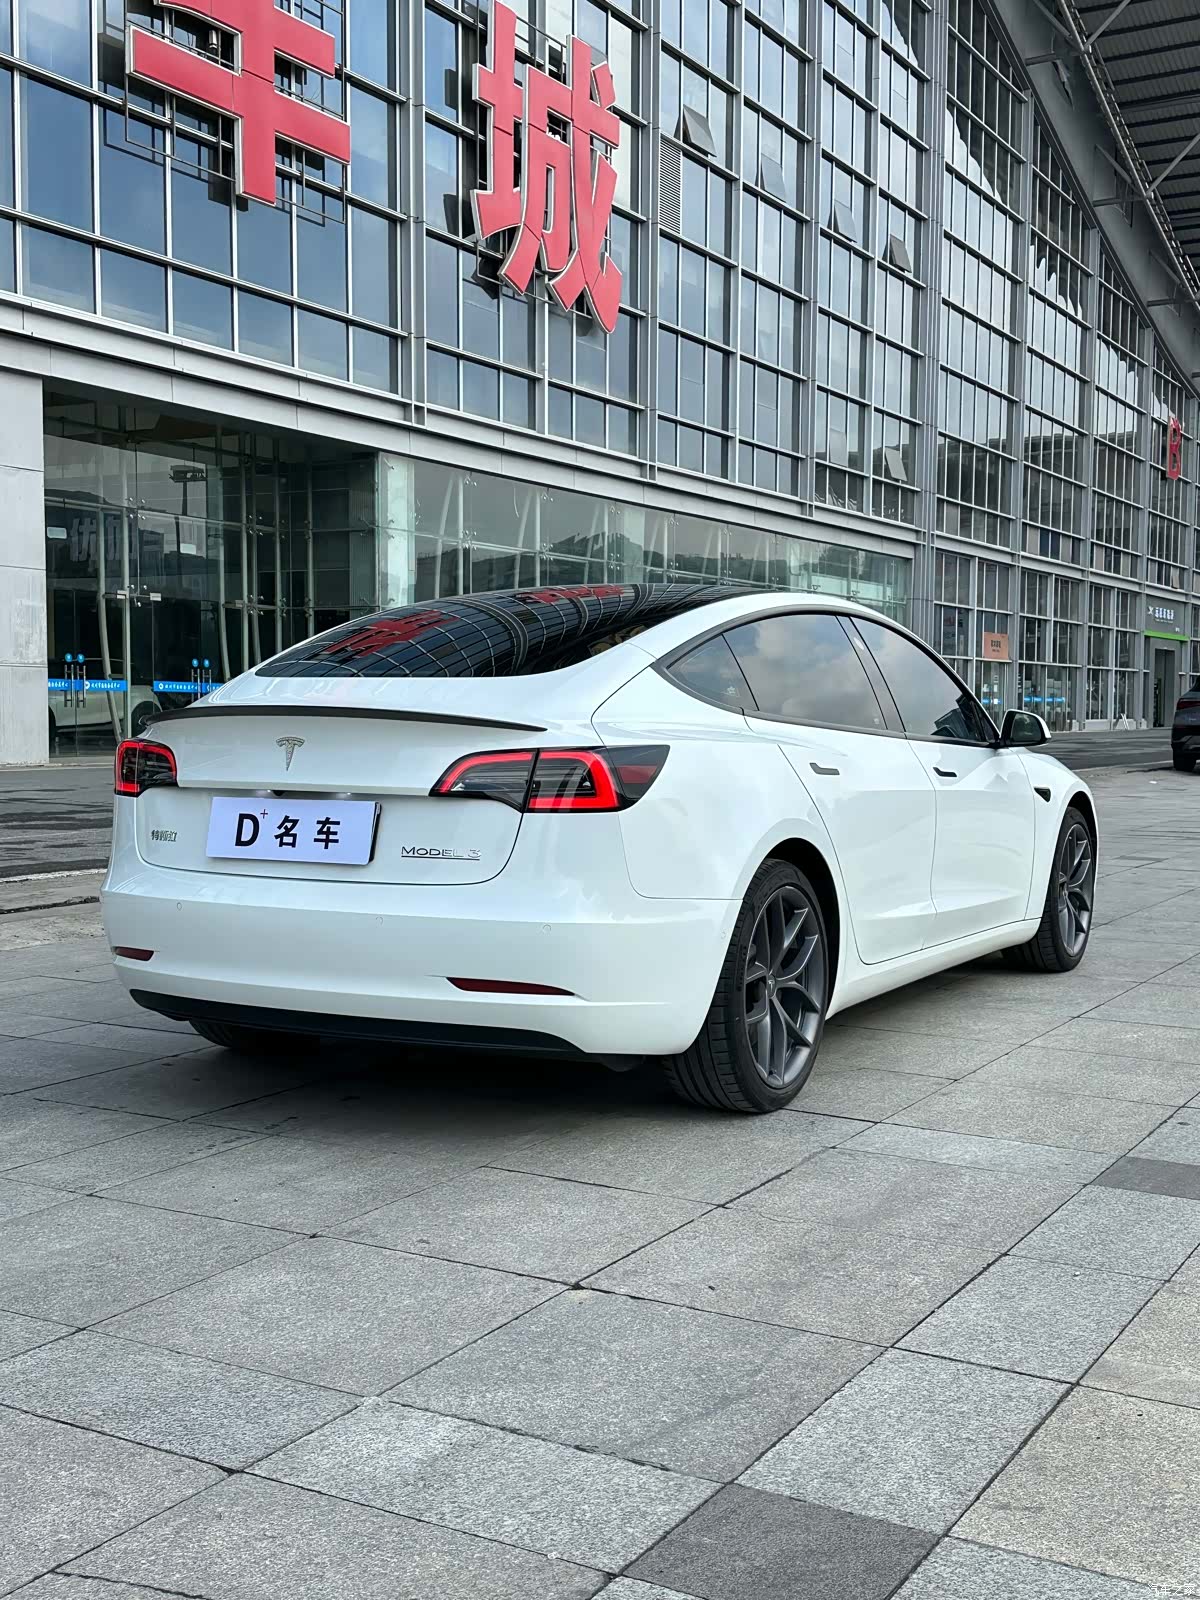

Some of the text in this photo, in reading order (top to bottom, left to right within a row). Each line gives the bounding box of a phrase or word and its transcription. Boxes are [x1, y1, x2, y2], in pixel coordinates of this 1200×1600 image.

[274, 815, 341, 850] 名车
[401, 846, 482, 859] MODEL 3
